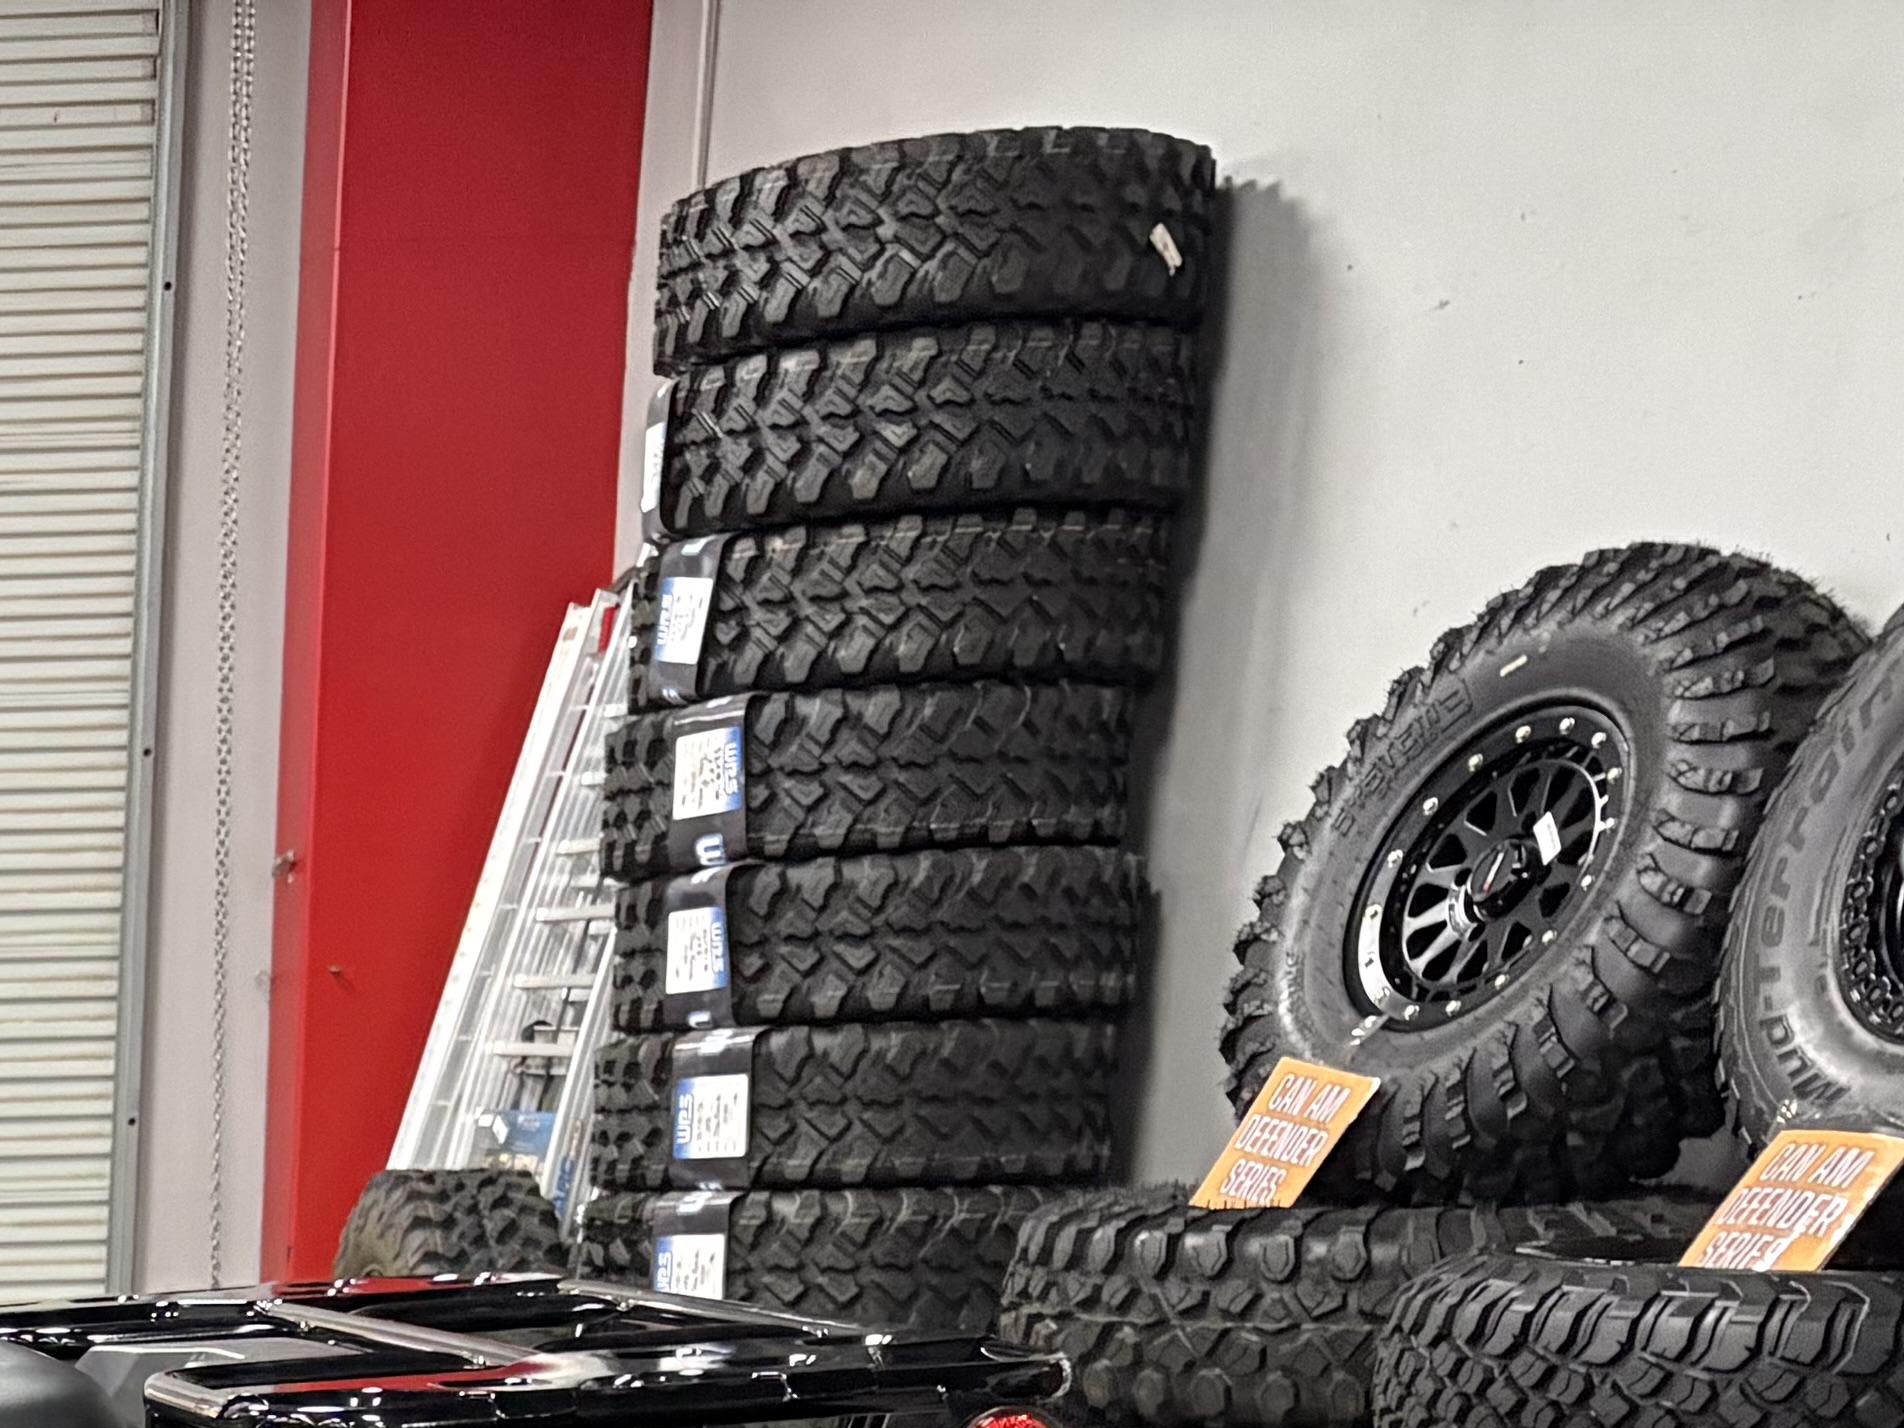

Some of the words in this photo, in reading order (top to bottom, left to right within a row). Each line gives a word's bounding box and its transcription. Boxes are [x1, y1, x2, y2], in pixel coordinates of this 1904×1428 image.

[722, 742, 739, 797] WPS
[710, 921, 725, 974] WPS
[676, 1093, 693, 1145] WPS
[1268, 1073, 1319, 1116] CAN
[1303, 1083, 1352, 1124] AM
[1234, 1113, 1329, 1168] DEFENDER
[1759, 1143, 1827, 1182] CAN
[1807, 1147, 1876, 1189] AM
[1220, 1157, 1288, 1207] SERIES
[1717, 1187, 1849, 1238] DEFENDER
